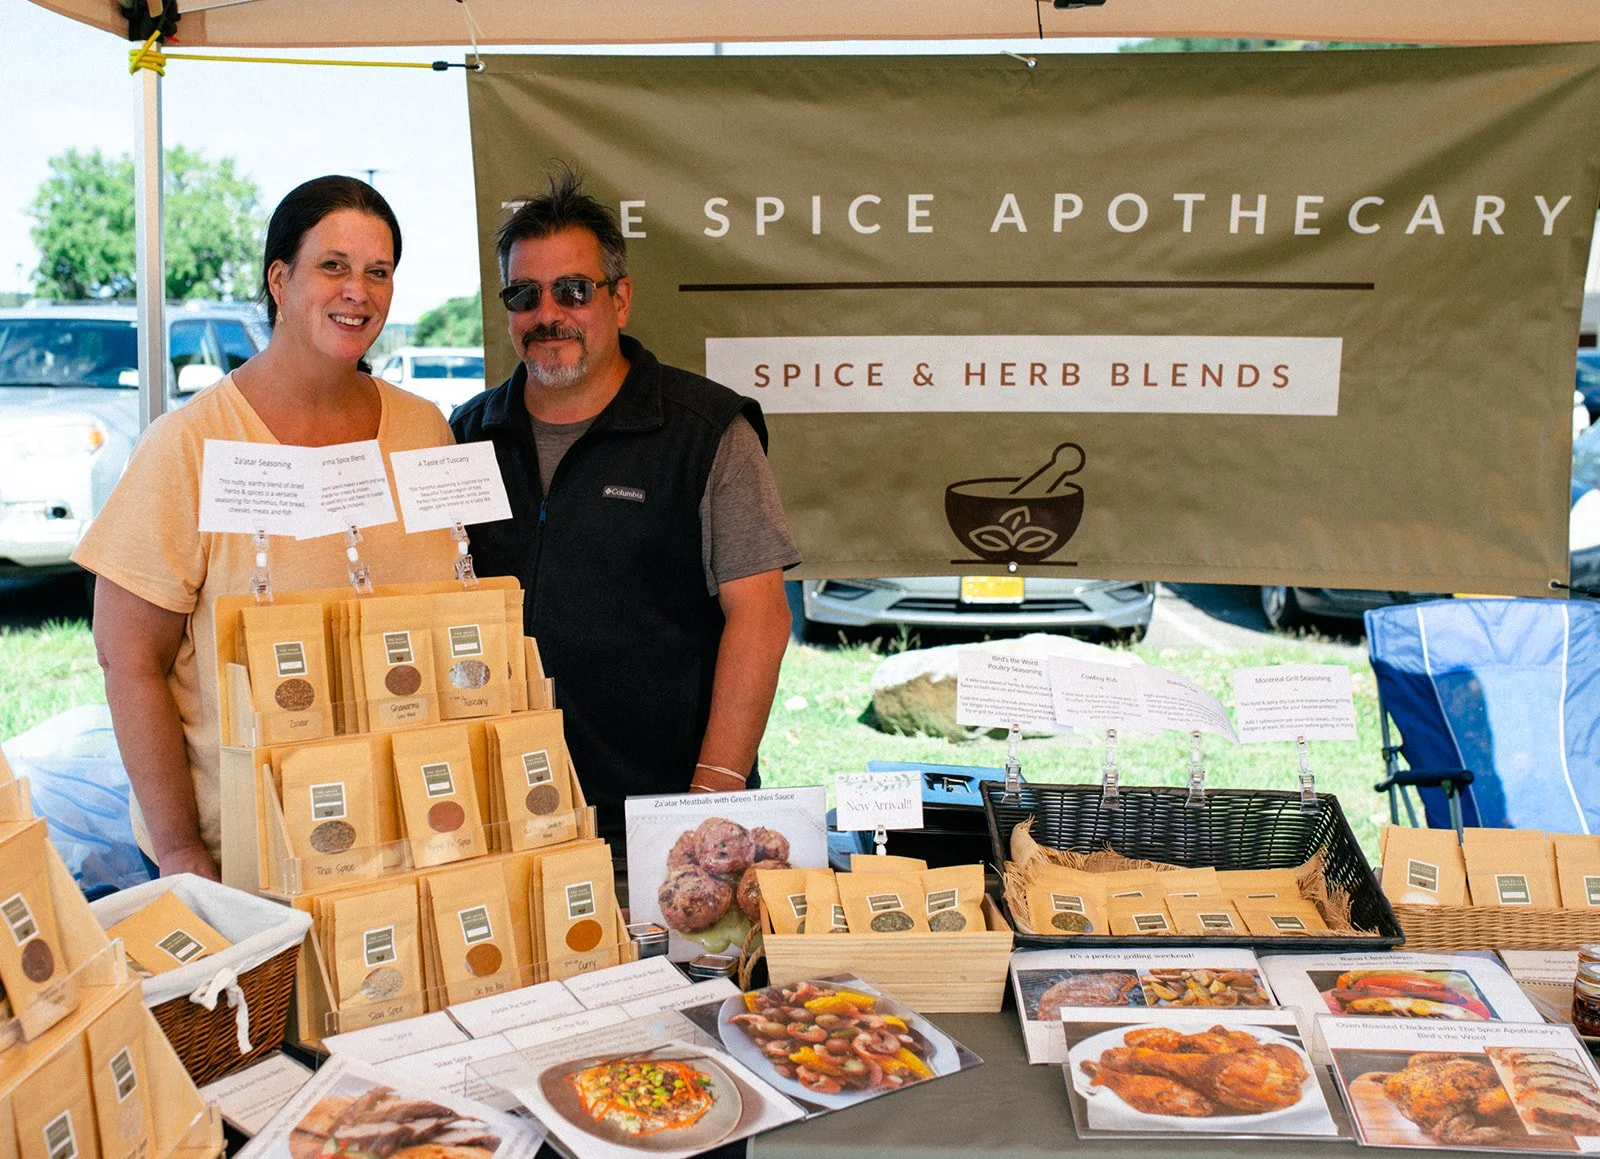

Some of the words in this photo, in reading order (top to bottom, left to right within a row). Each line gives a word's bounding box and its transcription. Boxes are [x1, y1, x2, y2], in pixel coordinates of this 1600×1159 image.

[703, 193, 935, 238] SPICE
[990, 192, 1571, 237] APOTHECARY
[753, 362, 884, 389] SPICE
[912, 362, 935, 388] &
[964, 362, 1080, 387] HERB
[1110, 362, 1290, 389] BLENDS
[235, 457, 257, 465] Za'atar
[259, 459, 291, 470] Seasoning
[447, 456, 470, 464] Tuscany
[611, 488, 643, 499] Columbia
[992, 655, 1009, 663] Bird's
[988, 664, 1010, 672] Poultry
[1012, 666, 1042, 676] Seasoning
[1081, 673, 1104, 682] Cowboy
[1255, 676, 1285, 684] Montreal
[655, 800, 677, 808] Za'atar
[679, 798, 713, 806] Meatballs
[731, 795, 751, 803] Green
[753, 794, 773, 802] Tahini
[775, 793, 795, 801] Sauce
[846, 800, 870, 811] New
[1336, 1022, 1360, 1030] Oven
[1362, 1023, 1397, 1031] Roasted
[1400, 1024, 1435, 1032] Chicken
[1438, 1024, 1457, 1032] with
[1459, 1025, 1476, 1033] The
[1503, 1027, 1561, 1036] Apothecary's
